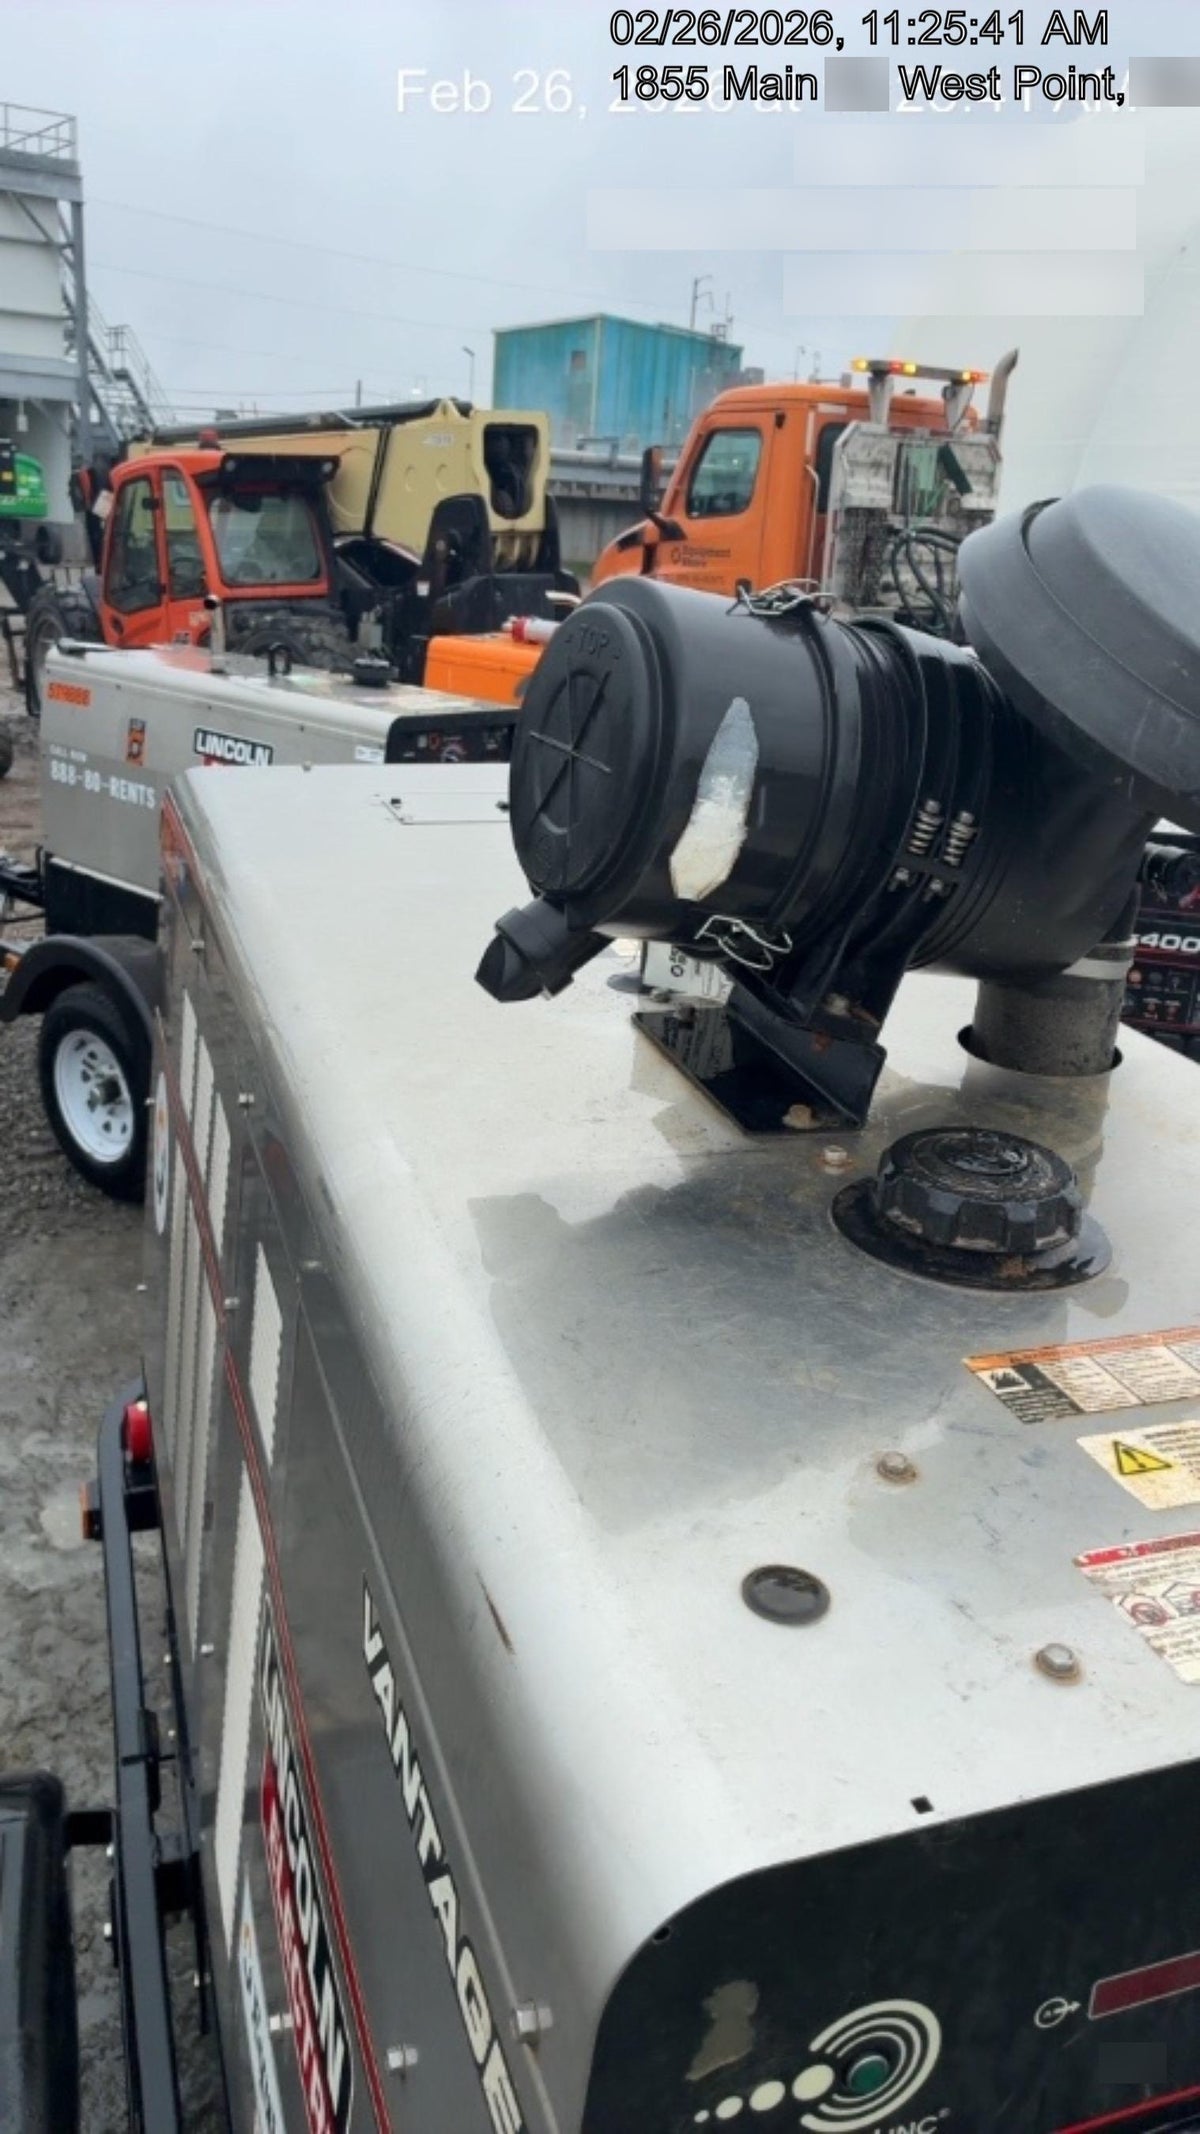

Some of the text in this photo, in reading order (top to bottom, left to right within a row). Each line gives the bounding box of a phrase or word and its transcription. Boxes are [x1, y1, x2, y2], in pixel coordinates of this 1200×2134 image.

[50, 759, 156, 809] 888-80-RENTS
[196, 730, 270, 767] LINCOLN
[263, 1620, 346, 2118] LINCOLN
[362, 1578, 526, 2134] VANTAGE
